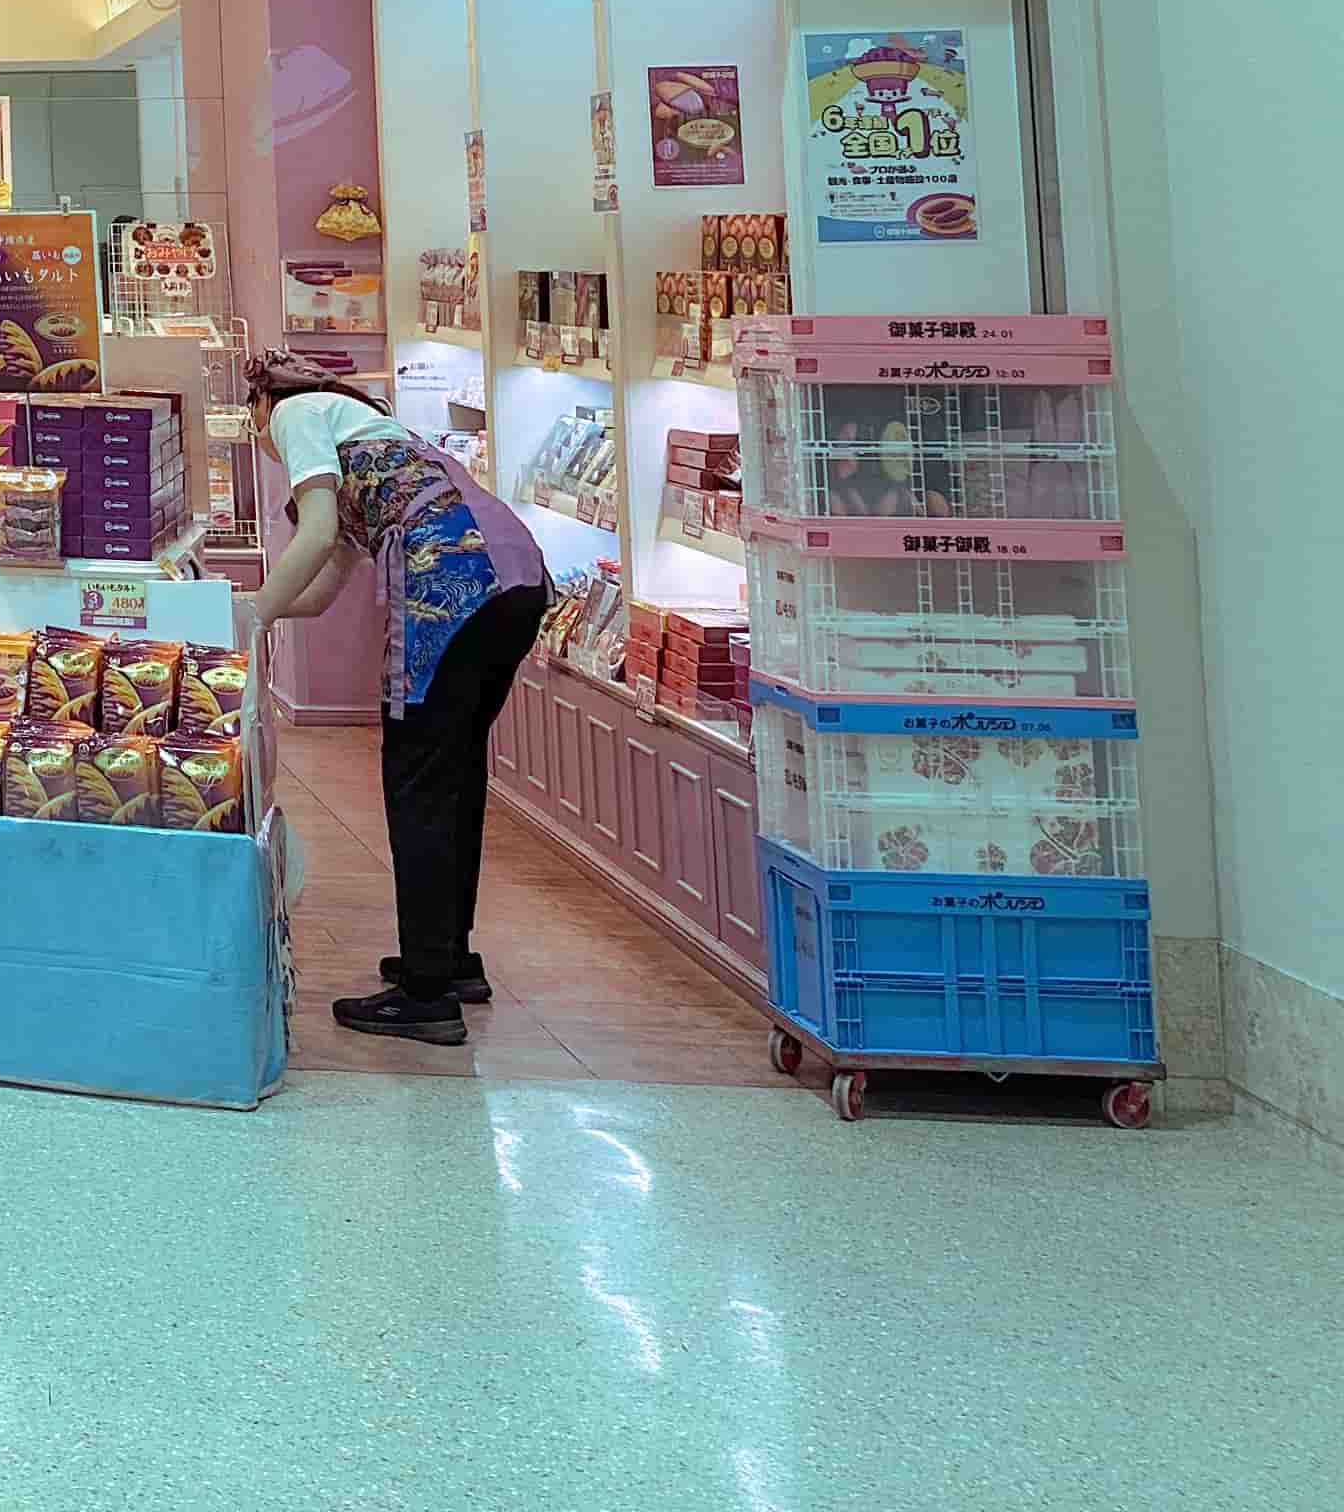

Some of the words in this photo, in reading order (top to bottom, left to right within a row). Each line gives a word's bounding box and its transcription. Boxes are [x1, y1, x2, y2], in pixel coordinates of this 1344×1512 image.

[888, 321, 977, 338] 御菓子御殿
[878, 361, 991, 379] お菓子のポルシェ
[902, 535, 992, 554] 御菓子御殿
[903, 711, 1017, 730] お菓子のポルシェ
